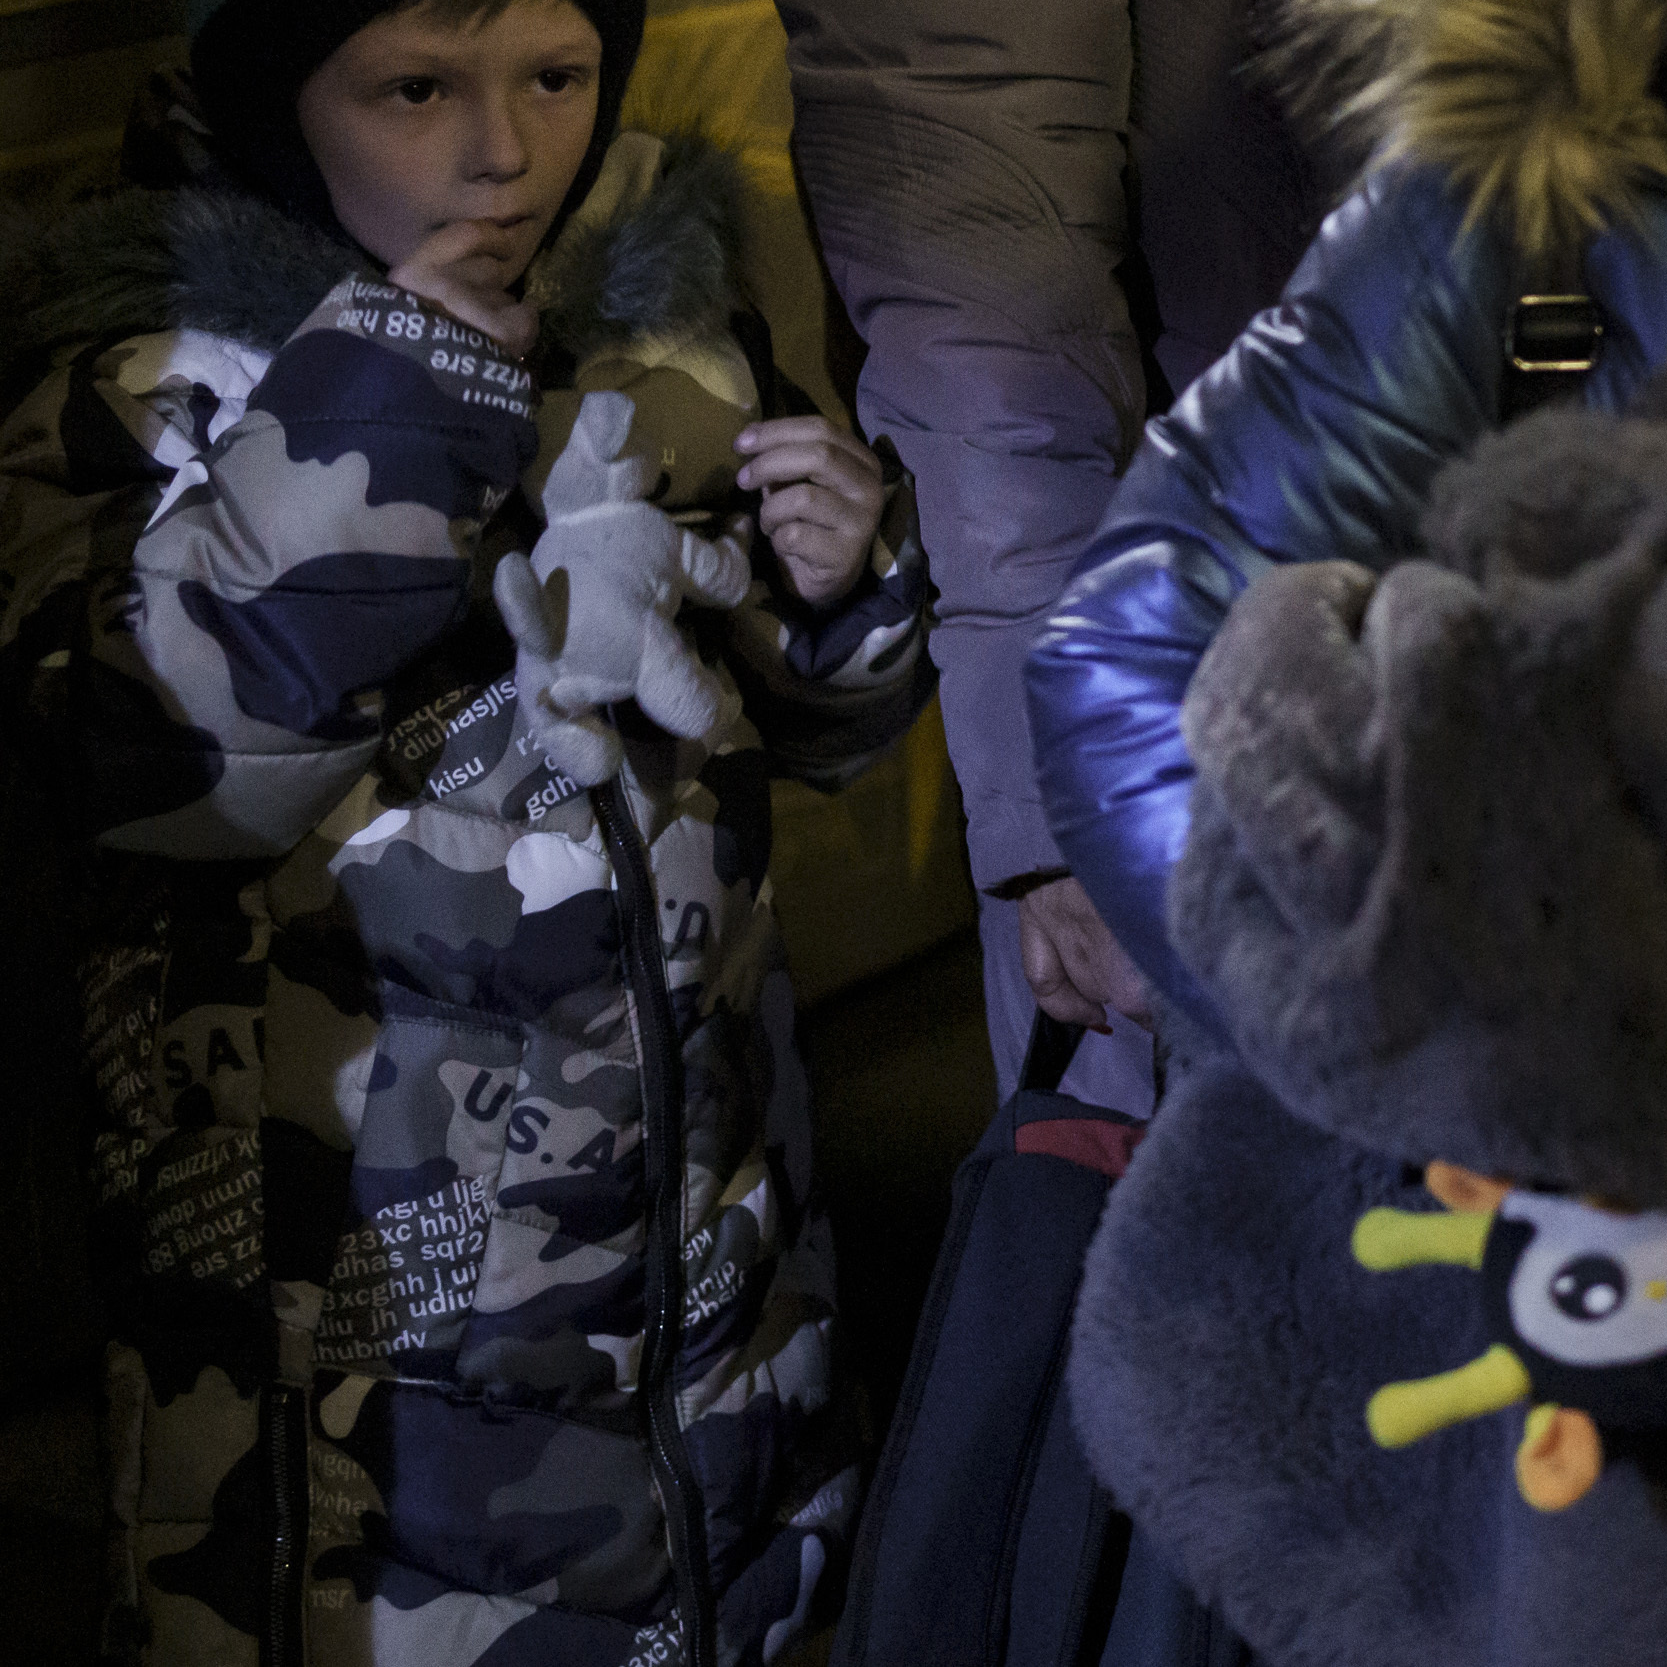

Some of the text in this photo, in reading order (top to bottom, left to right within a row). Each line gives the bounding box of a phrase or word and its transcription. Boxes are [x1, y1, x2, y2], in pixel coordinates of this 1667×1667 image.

[386, 310, 427, 341] 88
[428, 756, 486, 800] kisu
[524, 773, 578, 822] gdh
[421, 1230, 485, 1262] sqr2
